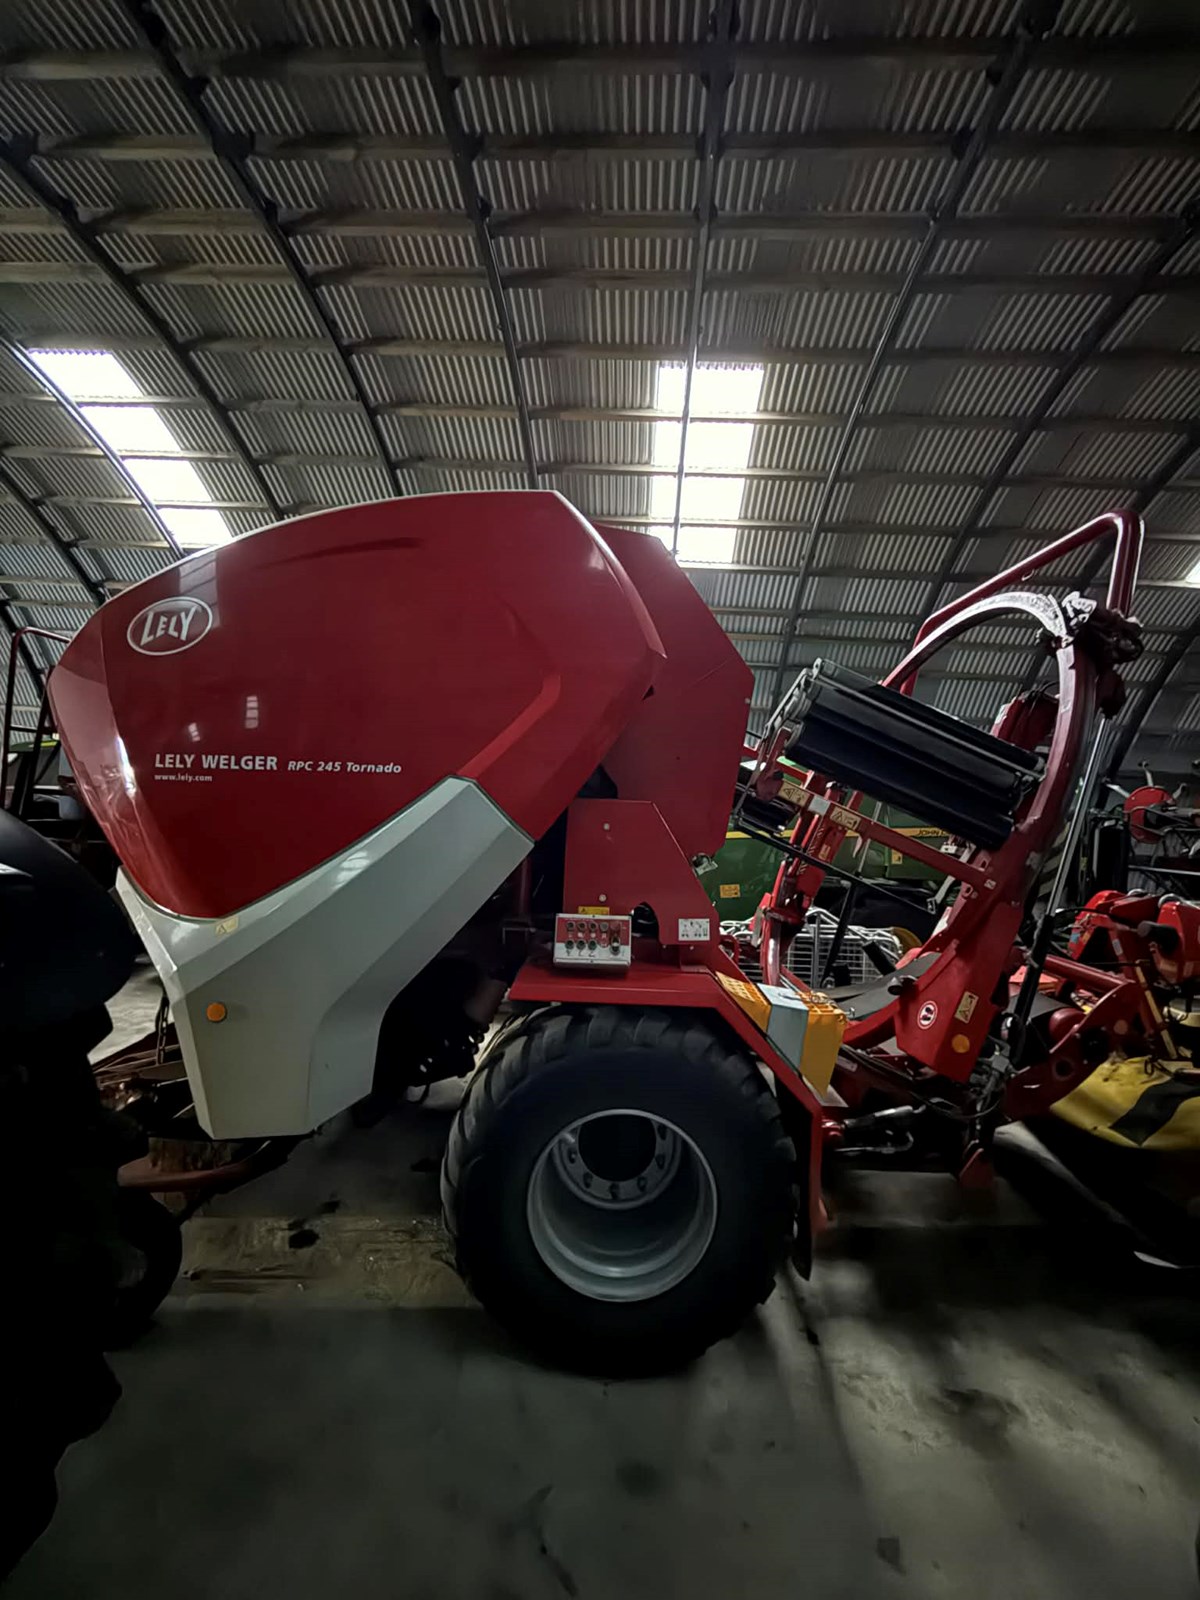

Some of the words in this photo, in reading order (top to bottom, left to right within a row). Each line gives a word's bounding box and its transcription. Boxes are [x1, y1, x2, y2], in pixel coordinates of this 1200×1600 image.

[140, 605, 199, 646] LELY
[154, 753, 196, 769] LELY
[201, 754, 278, 770] WELGER
[287, 761, 313, 772] RPC
[317, 761, 342, 772] 245
[346, 761, 402, 774] Tornado
[153, 773, 213, 784] www.lely.com
